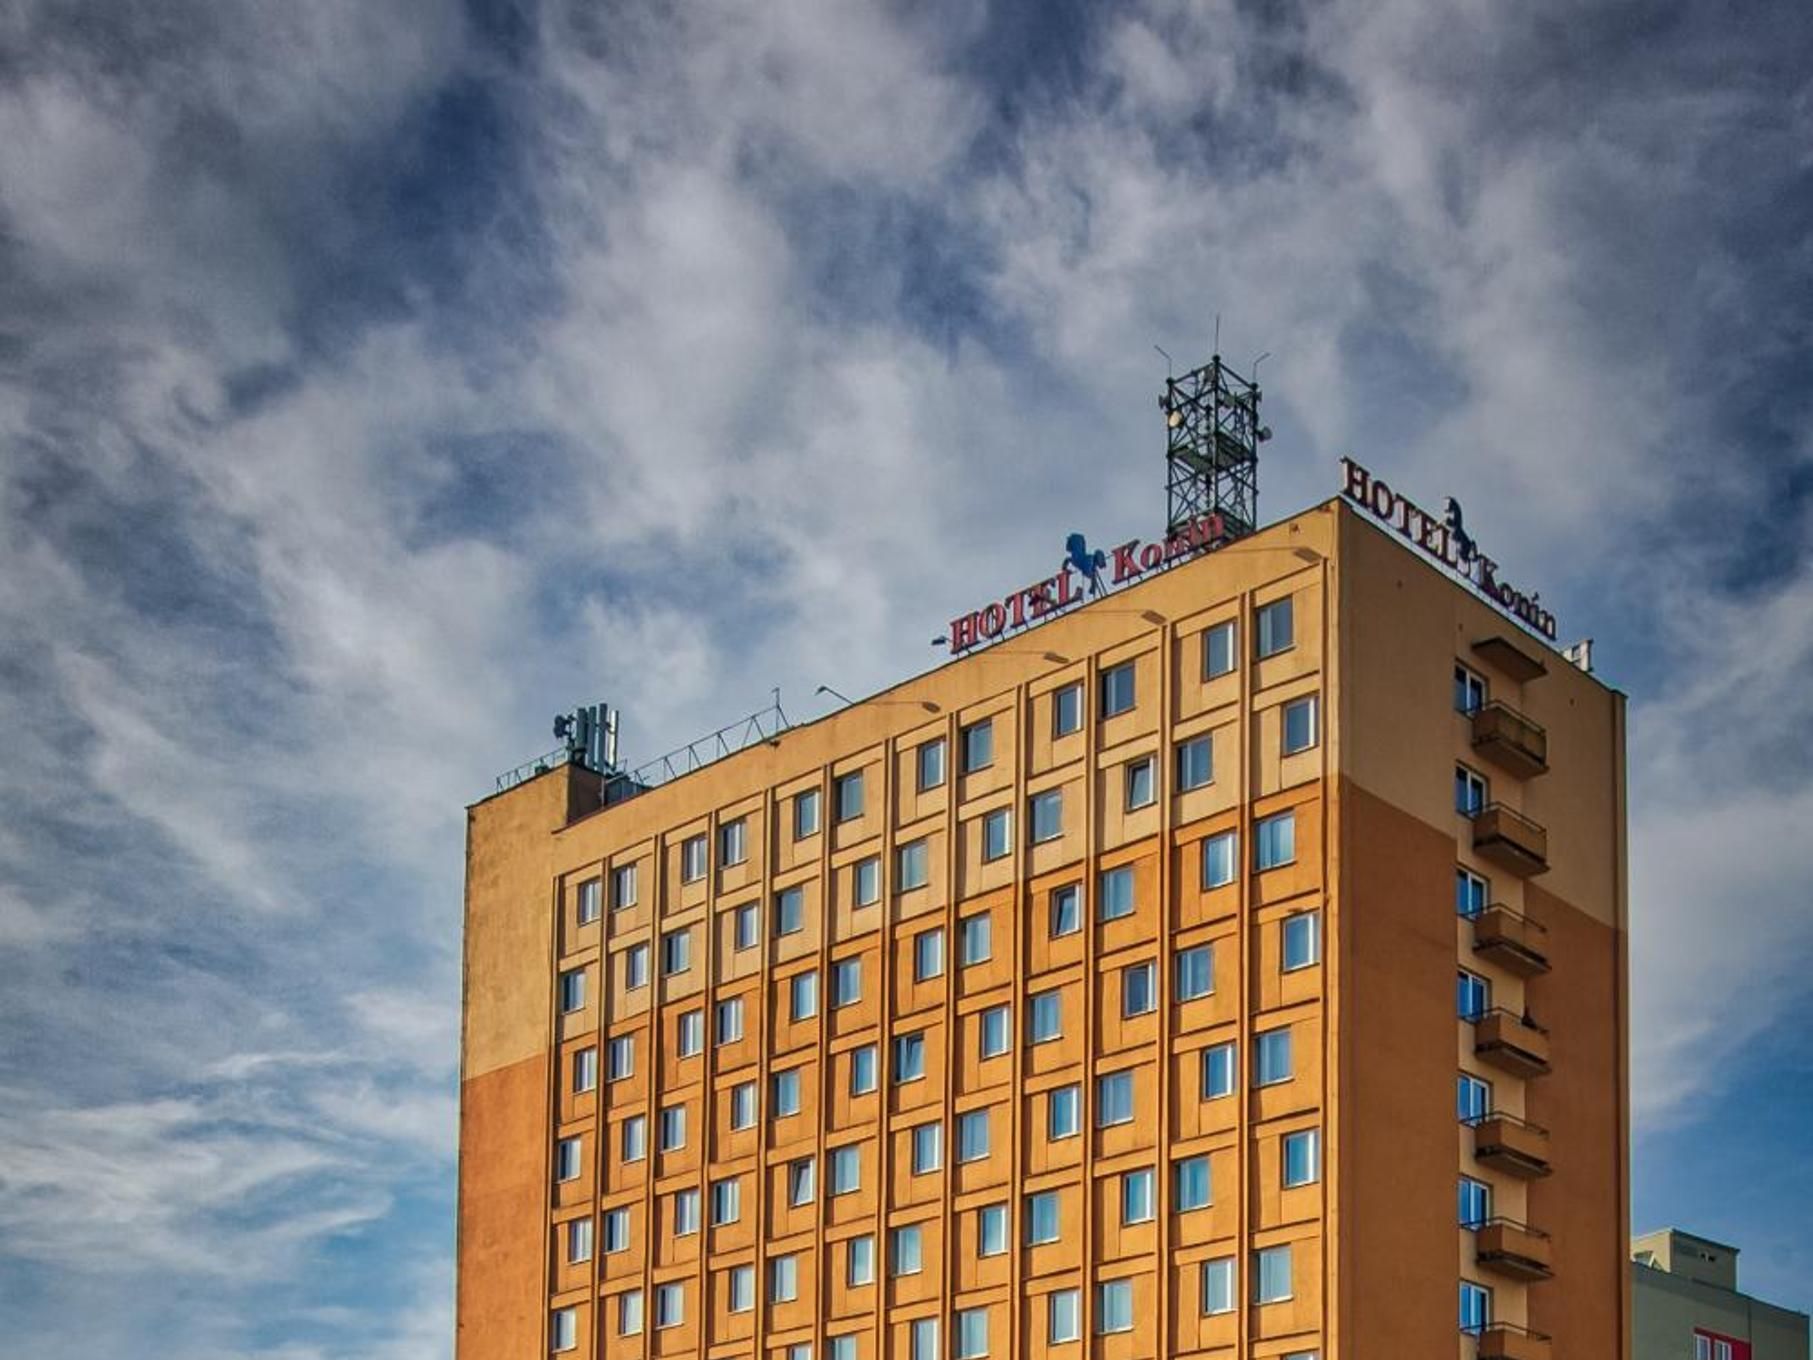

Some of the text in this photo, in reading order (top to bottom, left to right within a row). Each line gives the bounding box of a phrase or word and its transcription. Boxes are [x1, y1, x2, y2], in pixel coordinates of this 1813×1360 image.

[949, 512, 1230, 655] HOTEL Konin
[1340, 456, 1557, 641] HOTEL Konin
